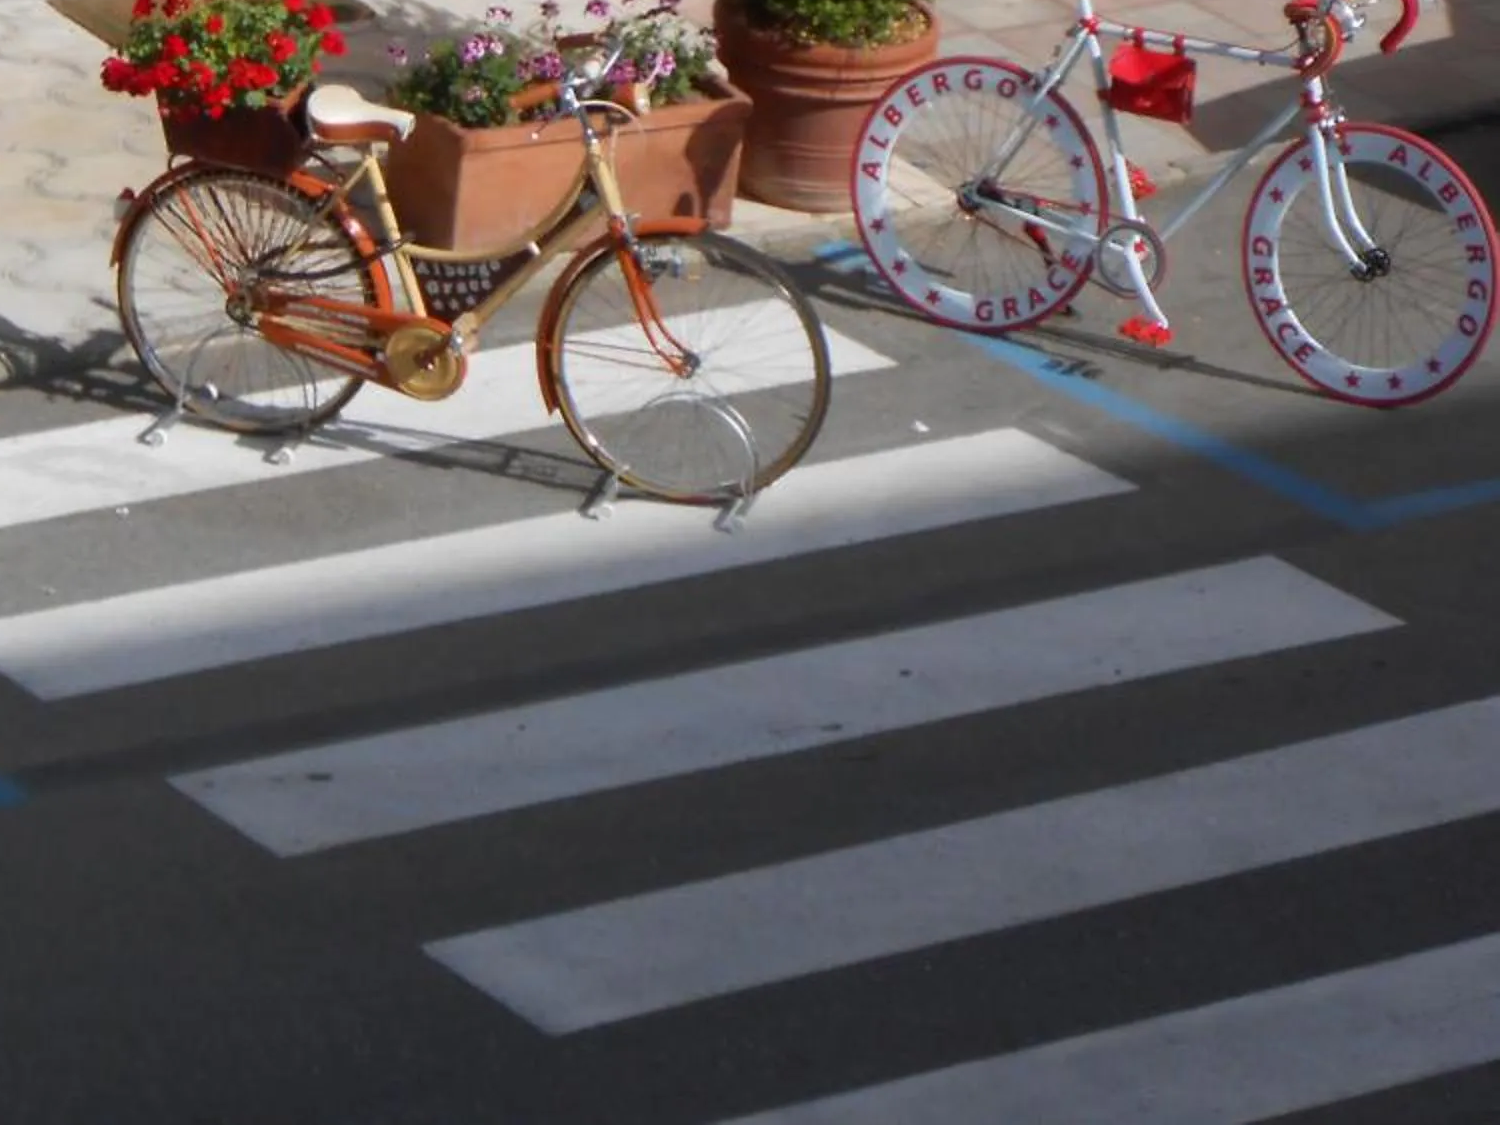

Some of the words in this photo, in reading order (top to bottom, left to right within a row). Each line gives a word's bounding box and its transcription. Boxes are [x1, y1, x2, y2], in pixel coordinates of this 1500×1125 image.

[861, 69, 1018, 182] ALBERGO
[975, 249, 1080, 322] GRACE
[1252, 235, 1317, 364] GRACE
[1388, 144, 1488, 338] ALBERGO
